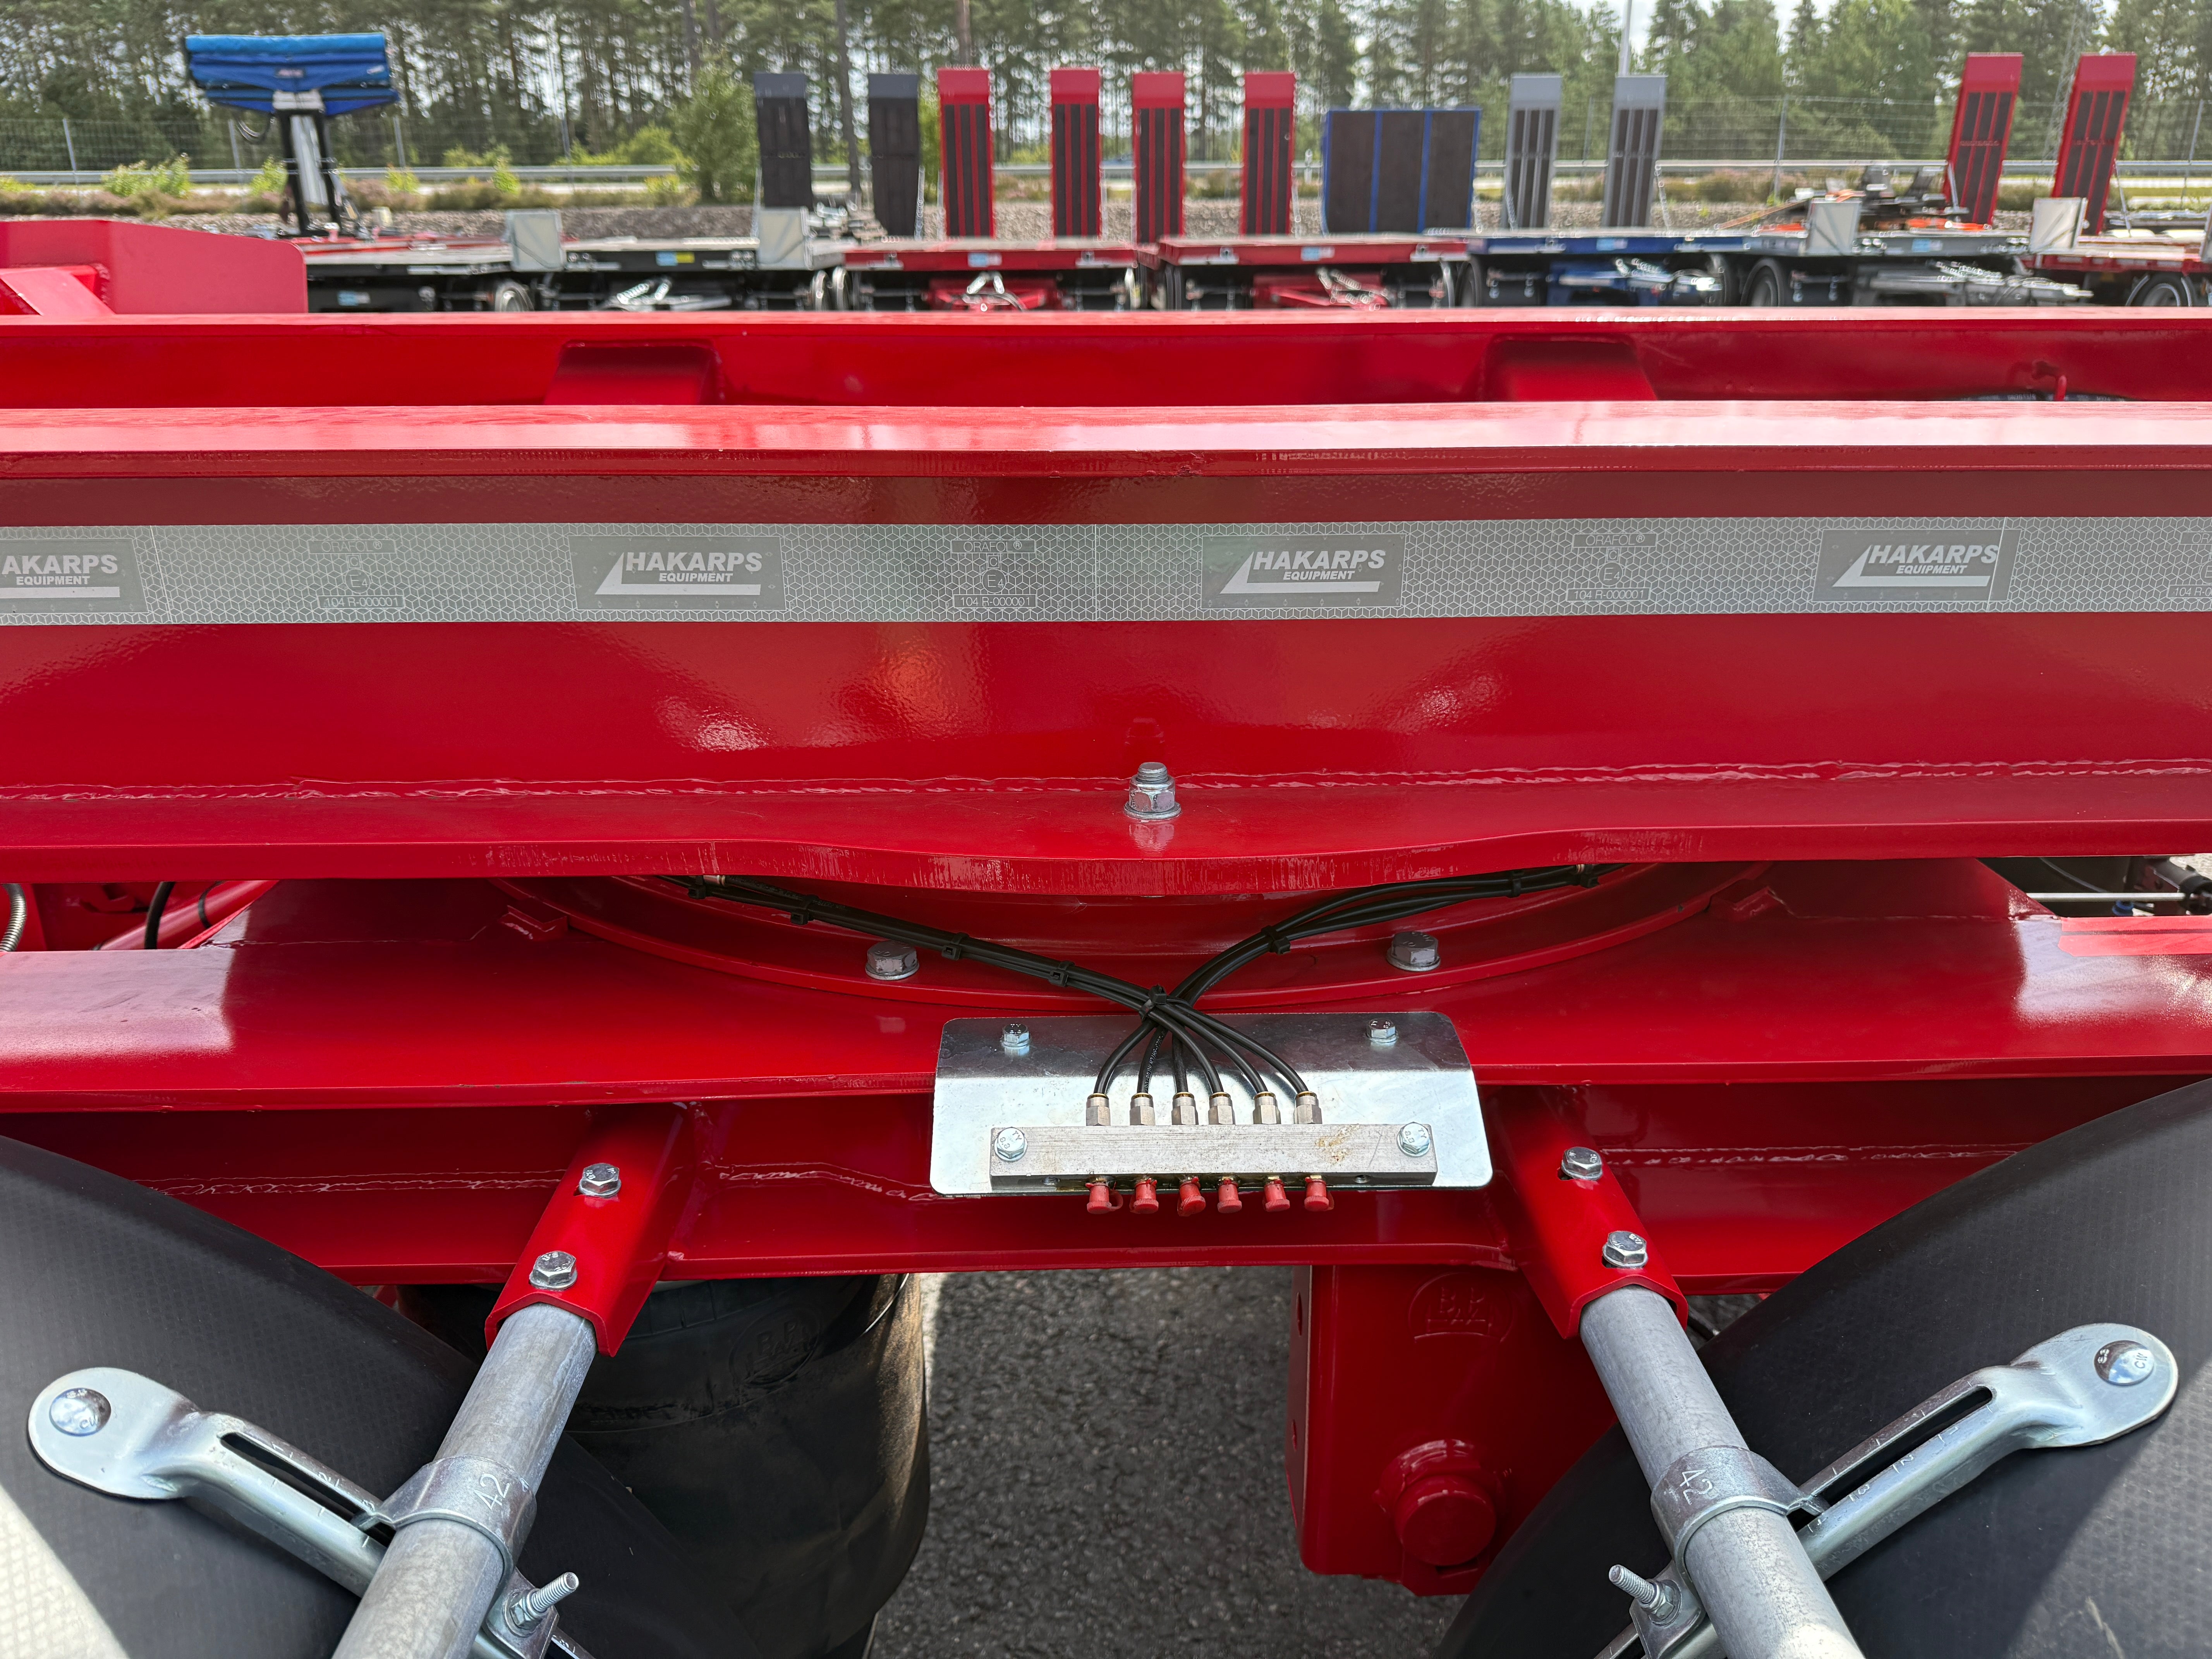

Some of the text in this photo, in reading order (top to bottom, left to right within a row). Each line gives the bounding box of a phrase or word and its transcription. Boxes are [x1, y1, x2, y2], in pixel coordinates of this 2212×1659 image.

[1609, 550, 1617, 560] C
[1869, 545, 1999, 563] HAKARPS
[2, 555, 118, 574] AKARPS
[350, 556, 358, 566] C
[626, 552, 762, 572] HAKARPS
[989, 557, 998, 566] C
[1253, 550, 1386, 570] HAKARPS
[1896, 565, 1967, 574] EQUIPMENT
[659, 573, 733, 582] EQUIPMENT
[1283, 570, 1355, 580] EQUIPMENT
[16, 576, 90, 585] EQUIPMENT
[1574, 590, 1644, 600] 104 R-000001
[2175, 587, 2212, 596] 104 R-0
[325, 597, 398, 607] 104 R-000001
[960, 597, 1030, 606] 104 R-000001
[1012, 1130, 1022, 1140] TY
[1418, 1128, 1427, 1139] TY
[1000, 1137, 1010, 1149] 8.8
[474, 1473, 510, 1510] 42
[1680, 1470, 1713, 1505] 42
